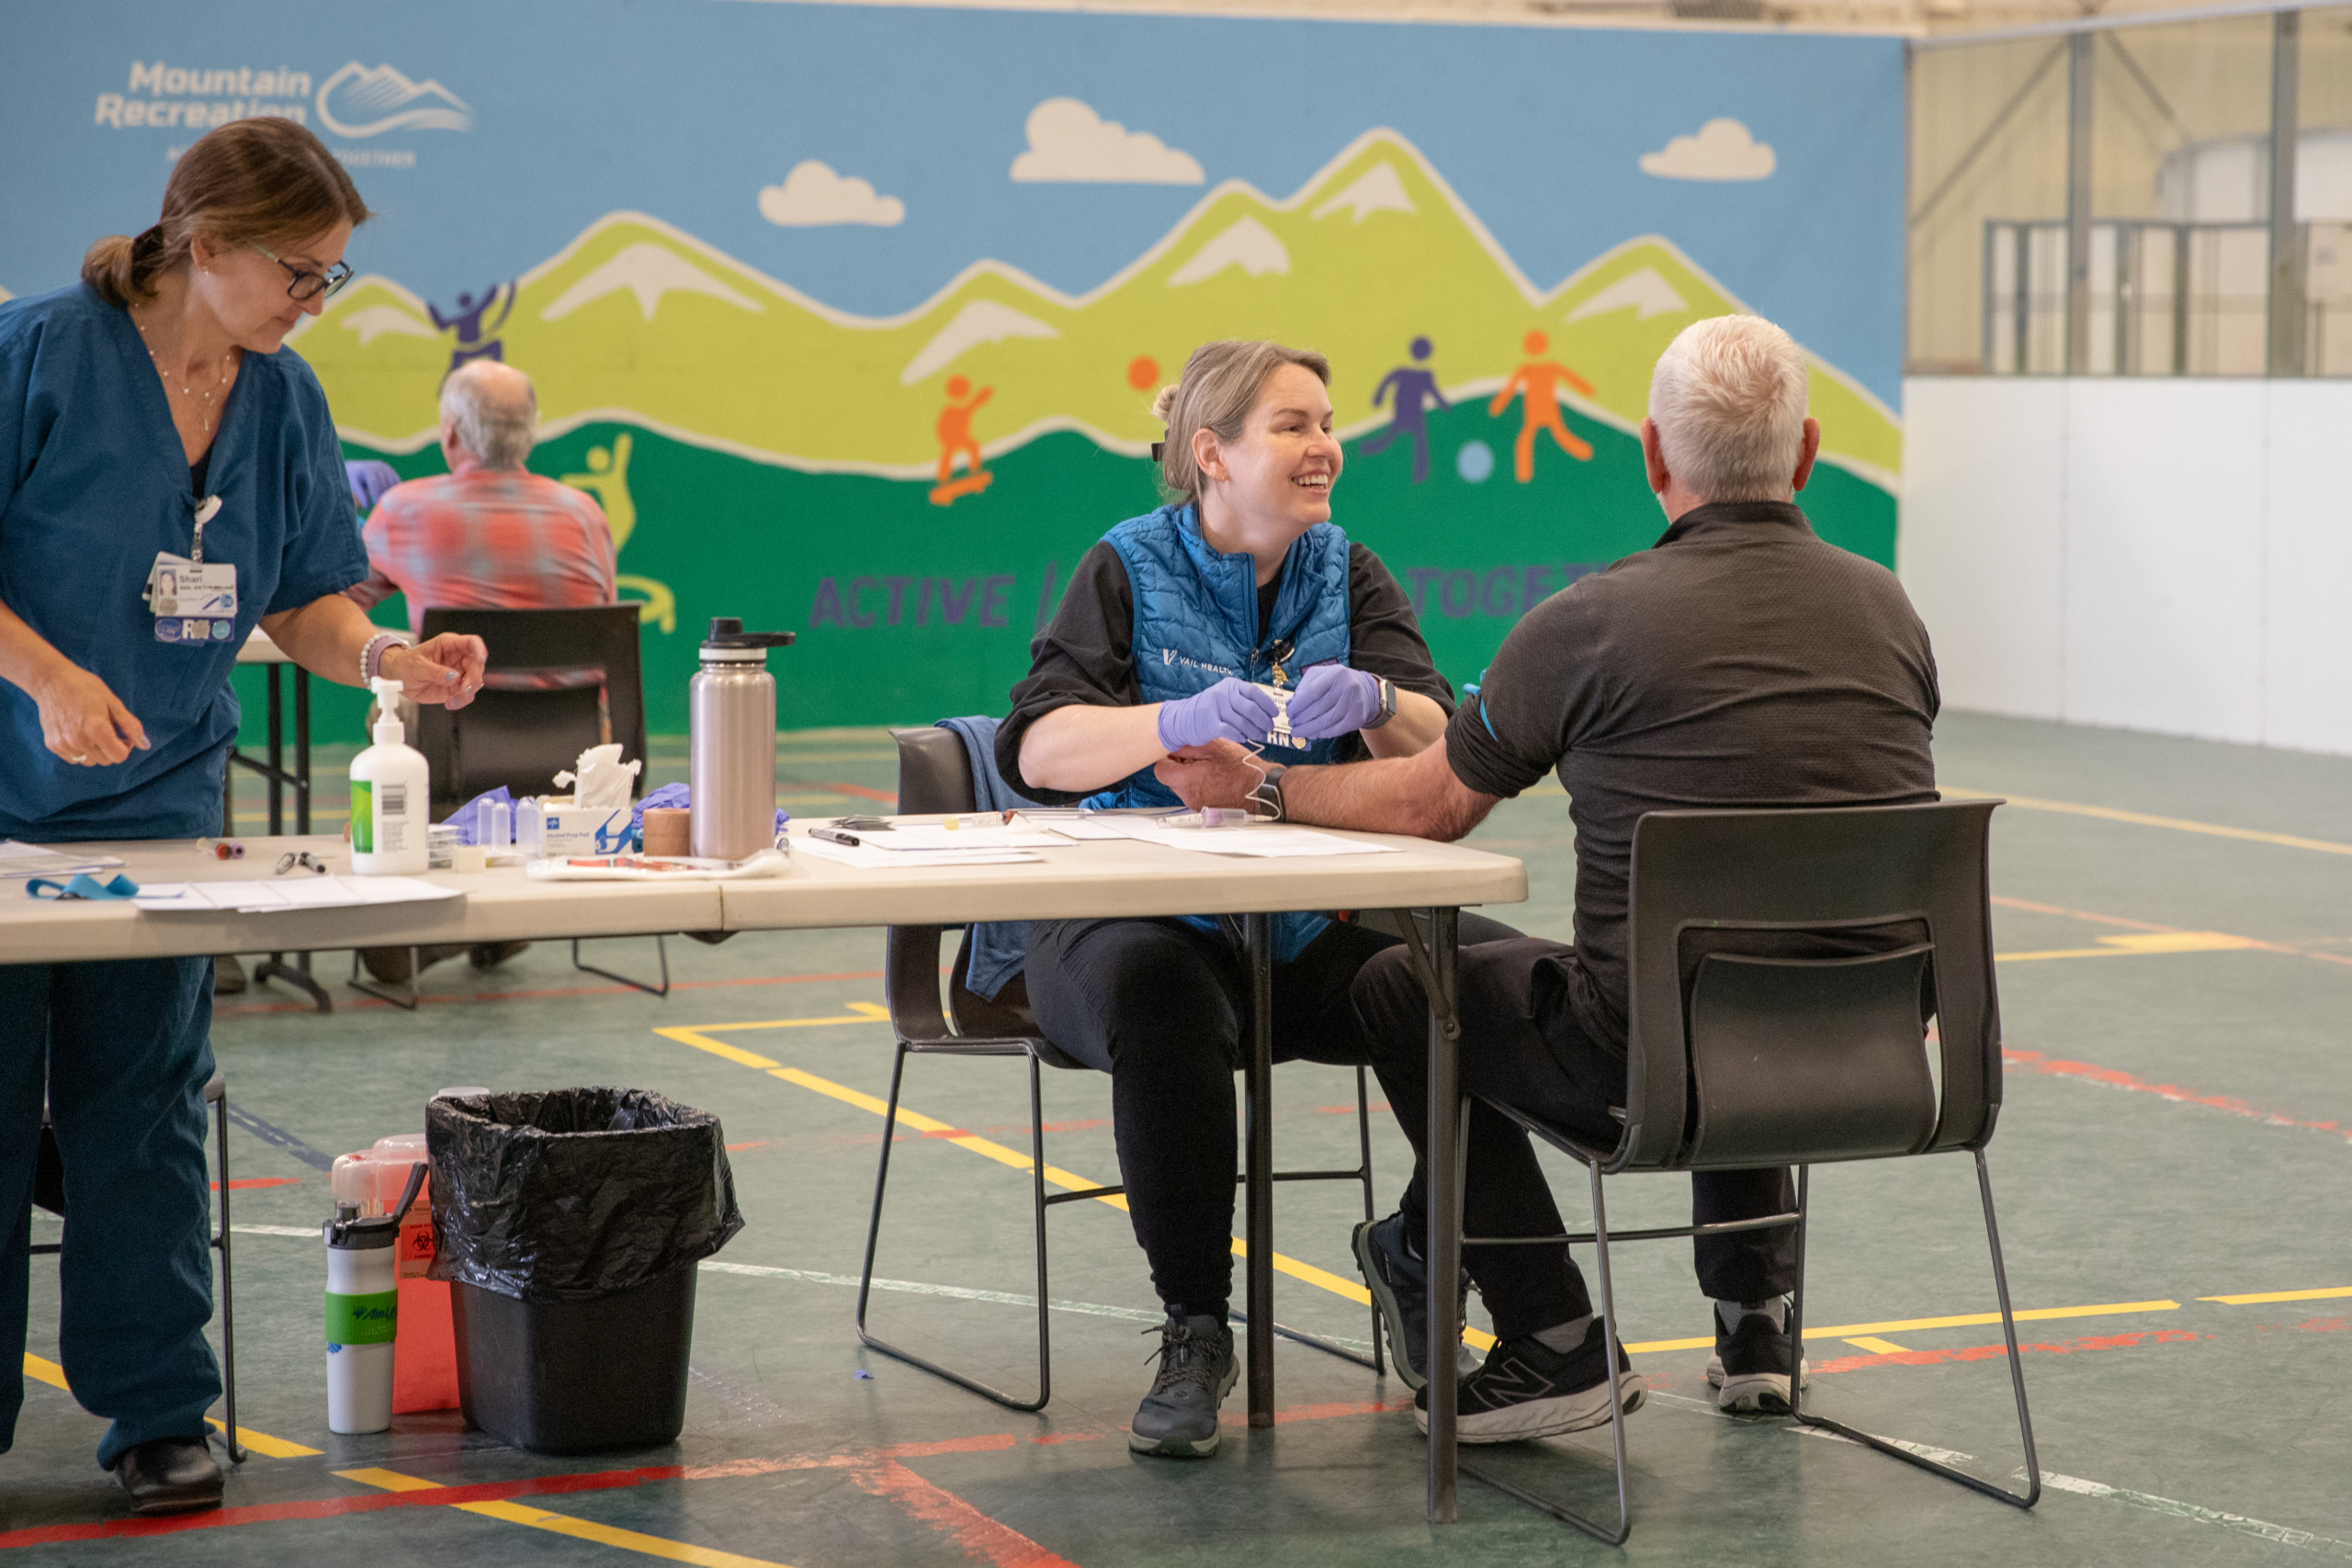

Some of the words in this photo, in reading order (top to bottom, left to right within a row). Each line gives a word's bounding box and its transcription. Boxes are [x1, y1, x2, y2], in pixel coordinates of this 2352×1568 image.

[129, 61, 312, 98] Mountain
[808, 573, 1016, 630] ACTIVE
[1180, 656, 1199, 669] VAIL
[1201, 662, 1234, 676] HEALTH
[1267, 731, 1290, 748] RN
